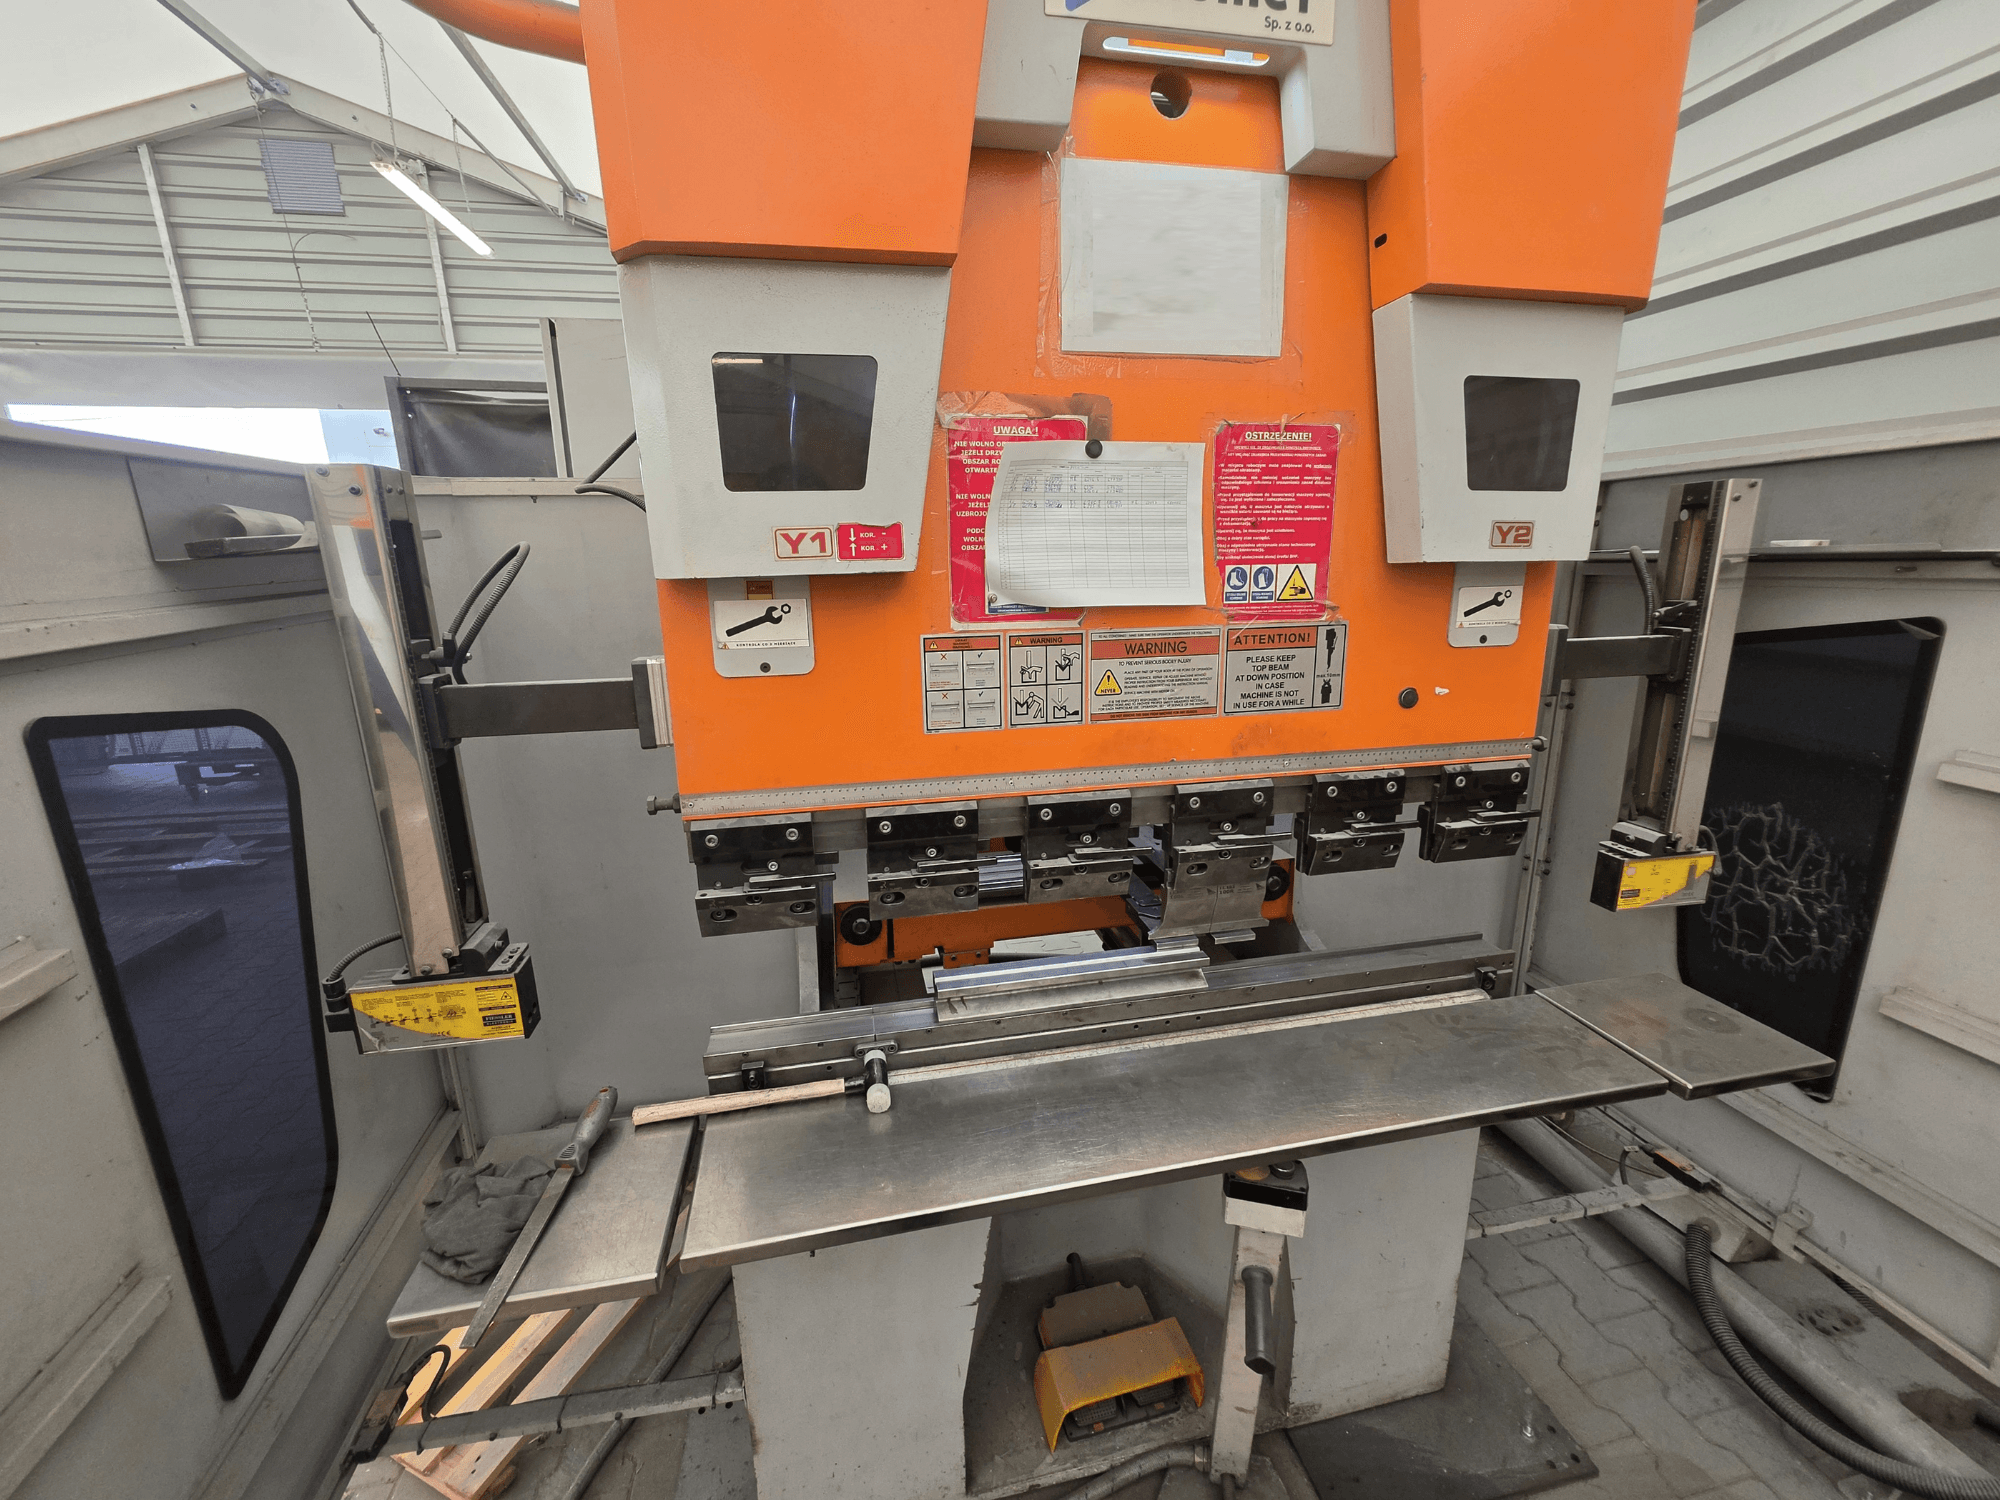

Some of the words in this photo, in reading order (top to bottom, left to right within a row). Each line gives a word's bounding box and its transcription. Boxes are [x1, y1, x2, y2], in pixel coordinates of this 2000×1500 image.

[1265, 15, 1281, 32] Sp.
[1285, 21, 1291, 30] z
[1295, 22, 1314, 33] o.o.
[993, 426, 1032, 435] UWAGA
[1496, 525, 1531, 543] Y2
[780, 532, 827, 554] Y1
[1234, 633, 1310, 645] ATTENTION!
[1125, 641, 1187, 655] WARNING
[1246, 655, 1274, 663] PLEASE
[1271, 672, 1305, 680] POSITION
[1240, 691, 1273, 699] MACHINE
